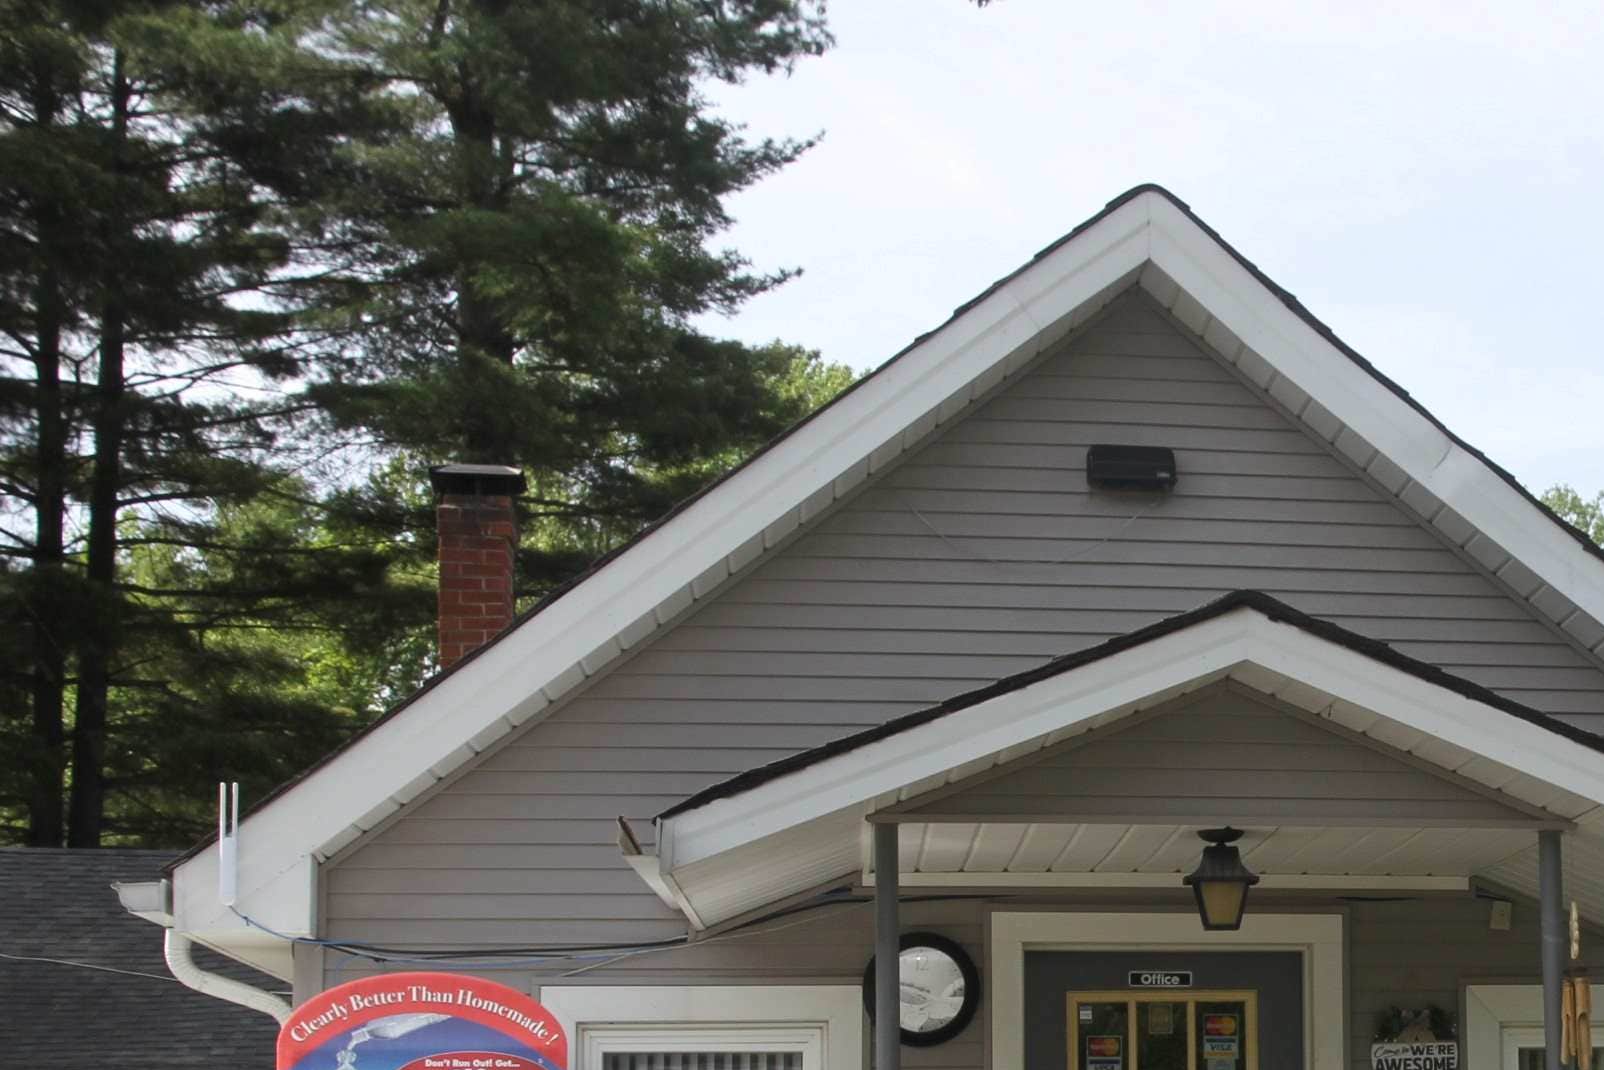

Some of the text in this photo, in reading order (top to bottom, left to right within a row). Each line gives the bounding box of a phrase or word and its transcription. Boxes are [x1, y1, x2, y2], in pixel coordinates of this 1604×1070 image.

[1141, 974, 1180, 985] Office
[290, 986, 559, 1046] Clearly Better Than Homemade!
[425, 1059, 450, 1067] Don't
[452, 1059, 470, 1067] Run
[473, 1059, 493, 1067] Out!
